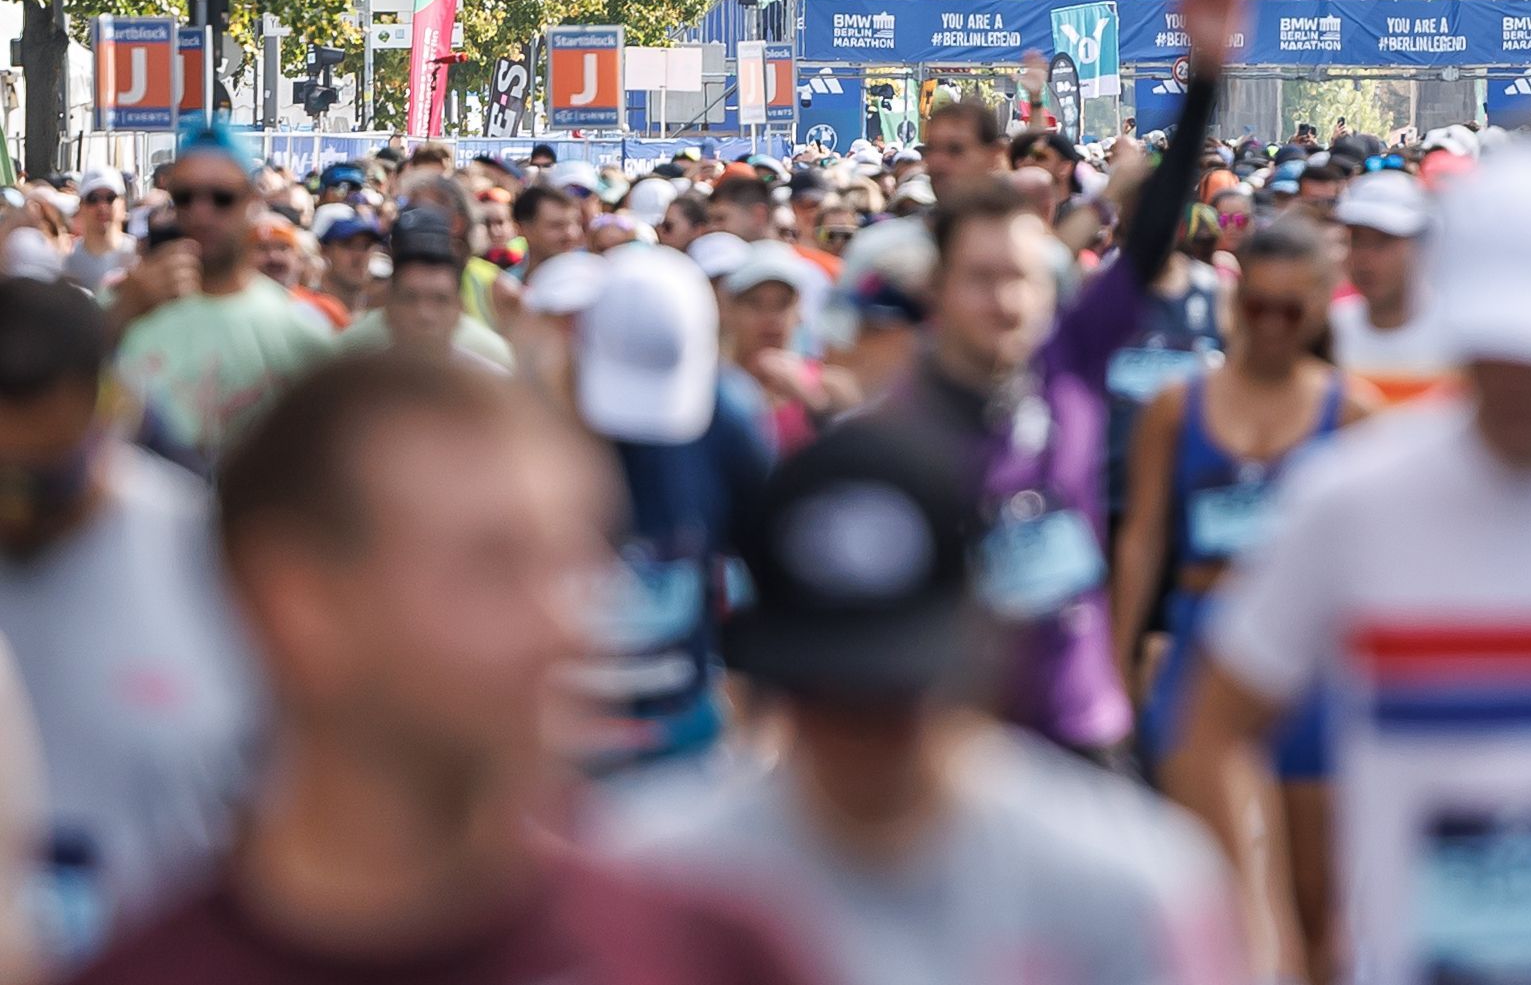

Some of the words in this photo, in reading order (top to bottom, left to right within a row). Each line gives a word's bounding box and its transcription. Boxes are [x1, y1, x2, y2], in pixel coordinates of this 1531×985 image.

[833, 14, 872, 28] BMW
[941, 13, 963, 29] YOU
[967, 14, 991, 29] ARE
[994, 13, 1004, 29] A
[1280, 17, 1318, 31] BMW
[1387, 17, 1411, 34] YOU
[1414, 18, 1437, 33] ARE
[1440, 17, 1449, 33] A
[833, 28, 872, 37] BERLIN
[931, 31, 1021, 47] #BERLINLEGEND
[1280, 31, 1319, 40] BERLIN
[554, 34, 617, 47] Startblock
[833, 37, 895, 49] MARATHON
[1280, 41, 1342, 51] MARATHON
[1378, 35, 1467, 52] #BERLINLEGEND
[117, 46, 147, 105] J
[570, 53, 597, 106] J
